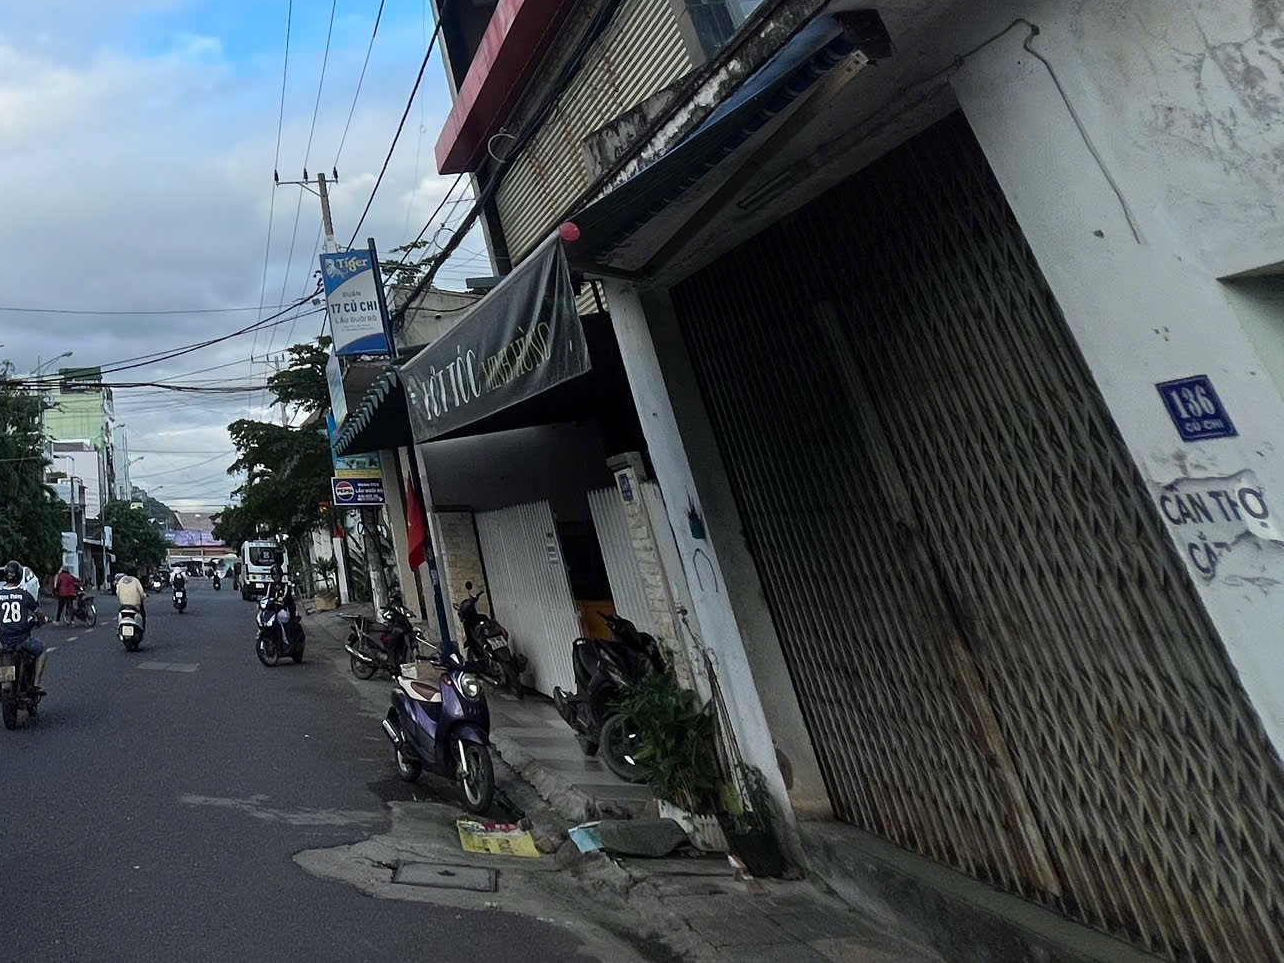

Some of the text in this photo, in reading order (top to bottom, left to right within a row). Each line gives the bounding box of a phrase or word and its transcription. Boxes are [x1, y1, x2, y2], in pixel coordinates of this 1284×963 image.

[337, 256, 368, 272] Tiger
[330, 298, 378, 314] 17 CỦ CHI
[446, 344, 481, 407] TÓC
[1169, 383, 1216, 420] 136
[1203, 418, 1224, 430] CHI
[1, 601, 21, 624] 28
